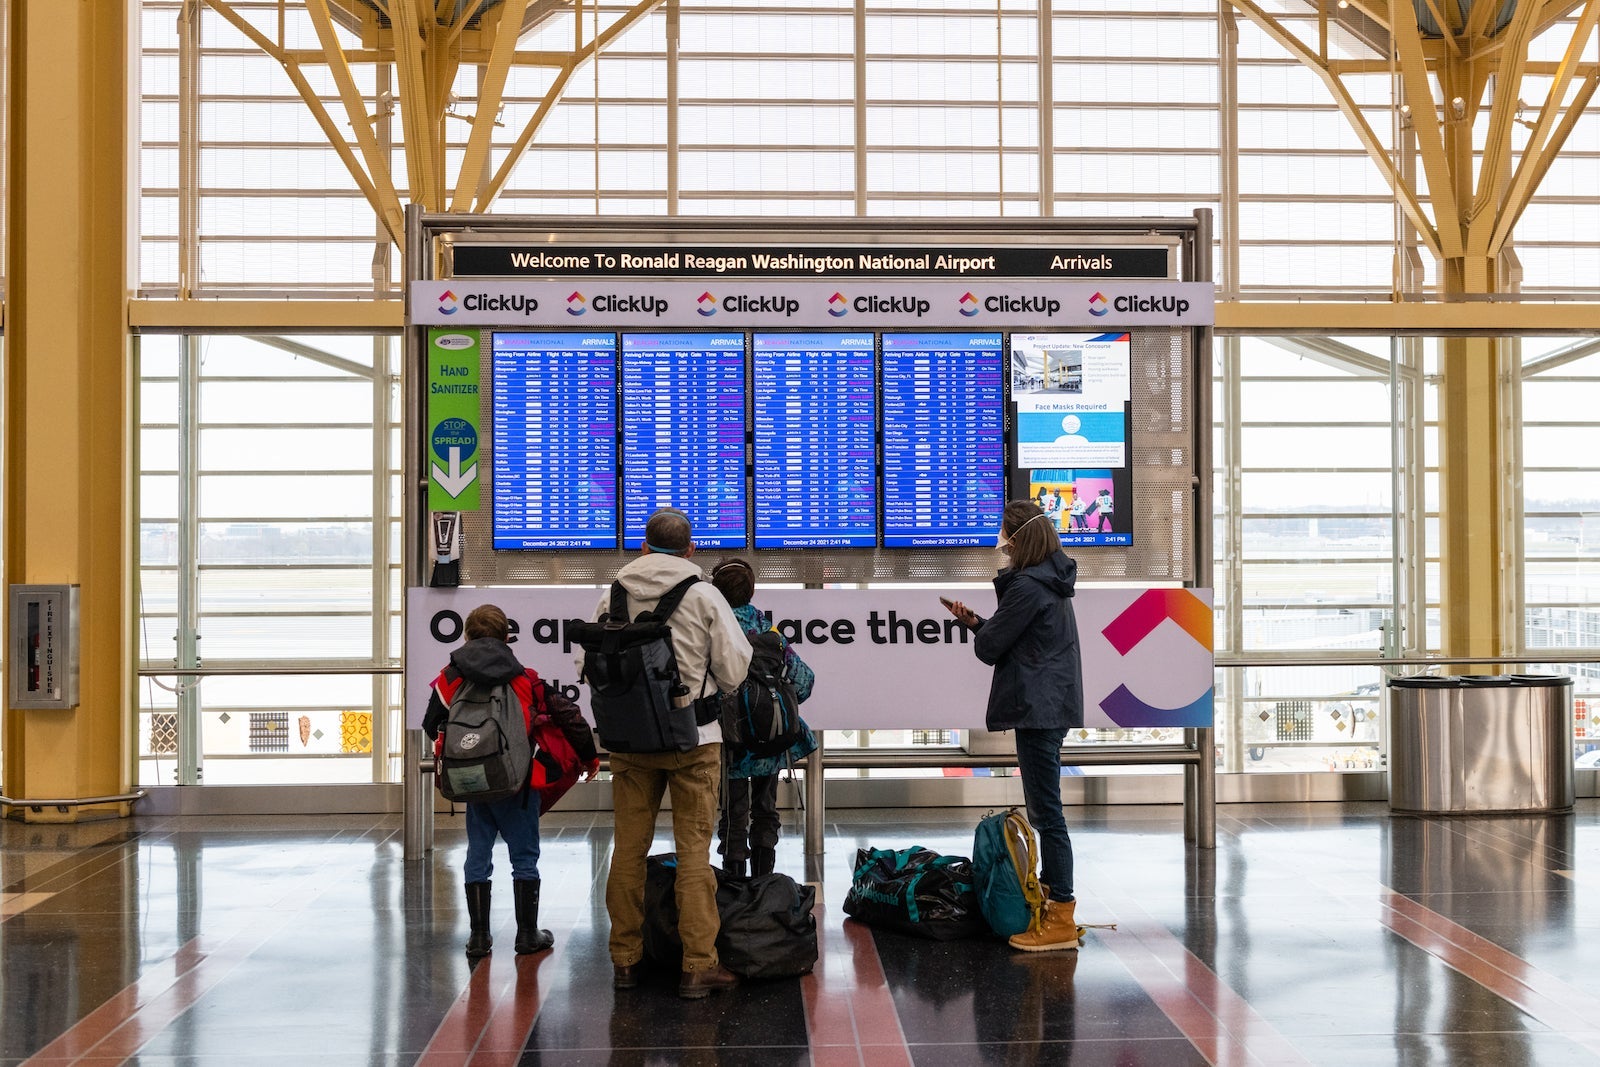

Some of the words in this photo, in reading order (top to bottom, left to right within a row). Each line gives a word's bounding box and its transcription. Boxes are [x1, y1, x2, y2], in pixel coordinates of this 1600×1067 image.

[511, 252, 590, 268] Welcome
[594, 254, 616, 268] To
[621, 253, 679, 268] Ronald
[685, 254, 747, 272] Reagan
[752, 254, 854, 273] Washington
[859, 254, 929, 269] National
[934, 255, 995, 273] Airport
[1050, 254, 1112, 269] Arrivals
[464, 293, 538, 316] ClickUp
[592, 294, 668, 317] ClickUp
[723, 295, 799, 317] ClickUp
[854, 295, 930, 317] ClickUp
[984, 295, 1060, 317] ClickUp
[1114, 295, 1189, 316] ClickUp
[440, 365, 469, 376] HAND
[431, 382, 478, 394] SANITIZER
[443, 420, 467, 430] STOP
[434, 437, 475, 445] SPREAD!
[430, 608, 520, 644] Oe
